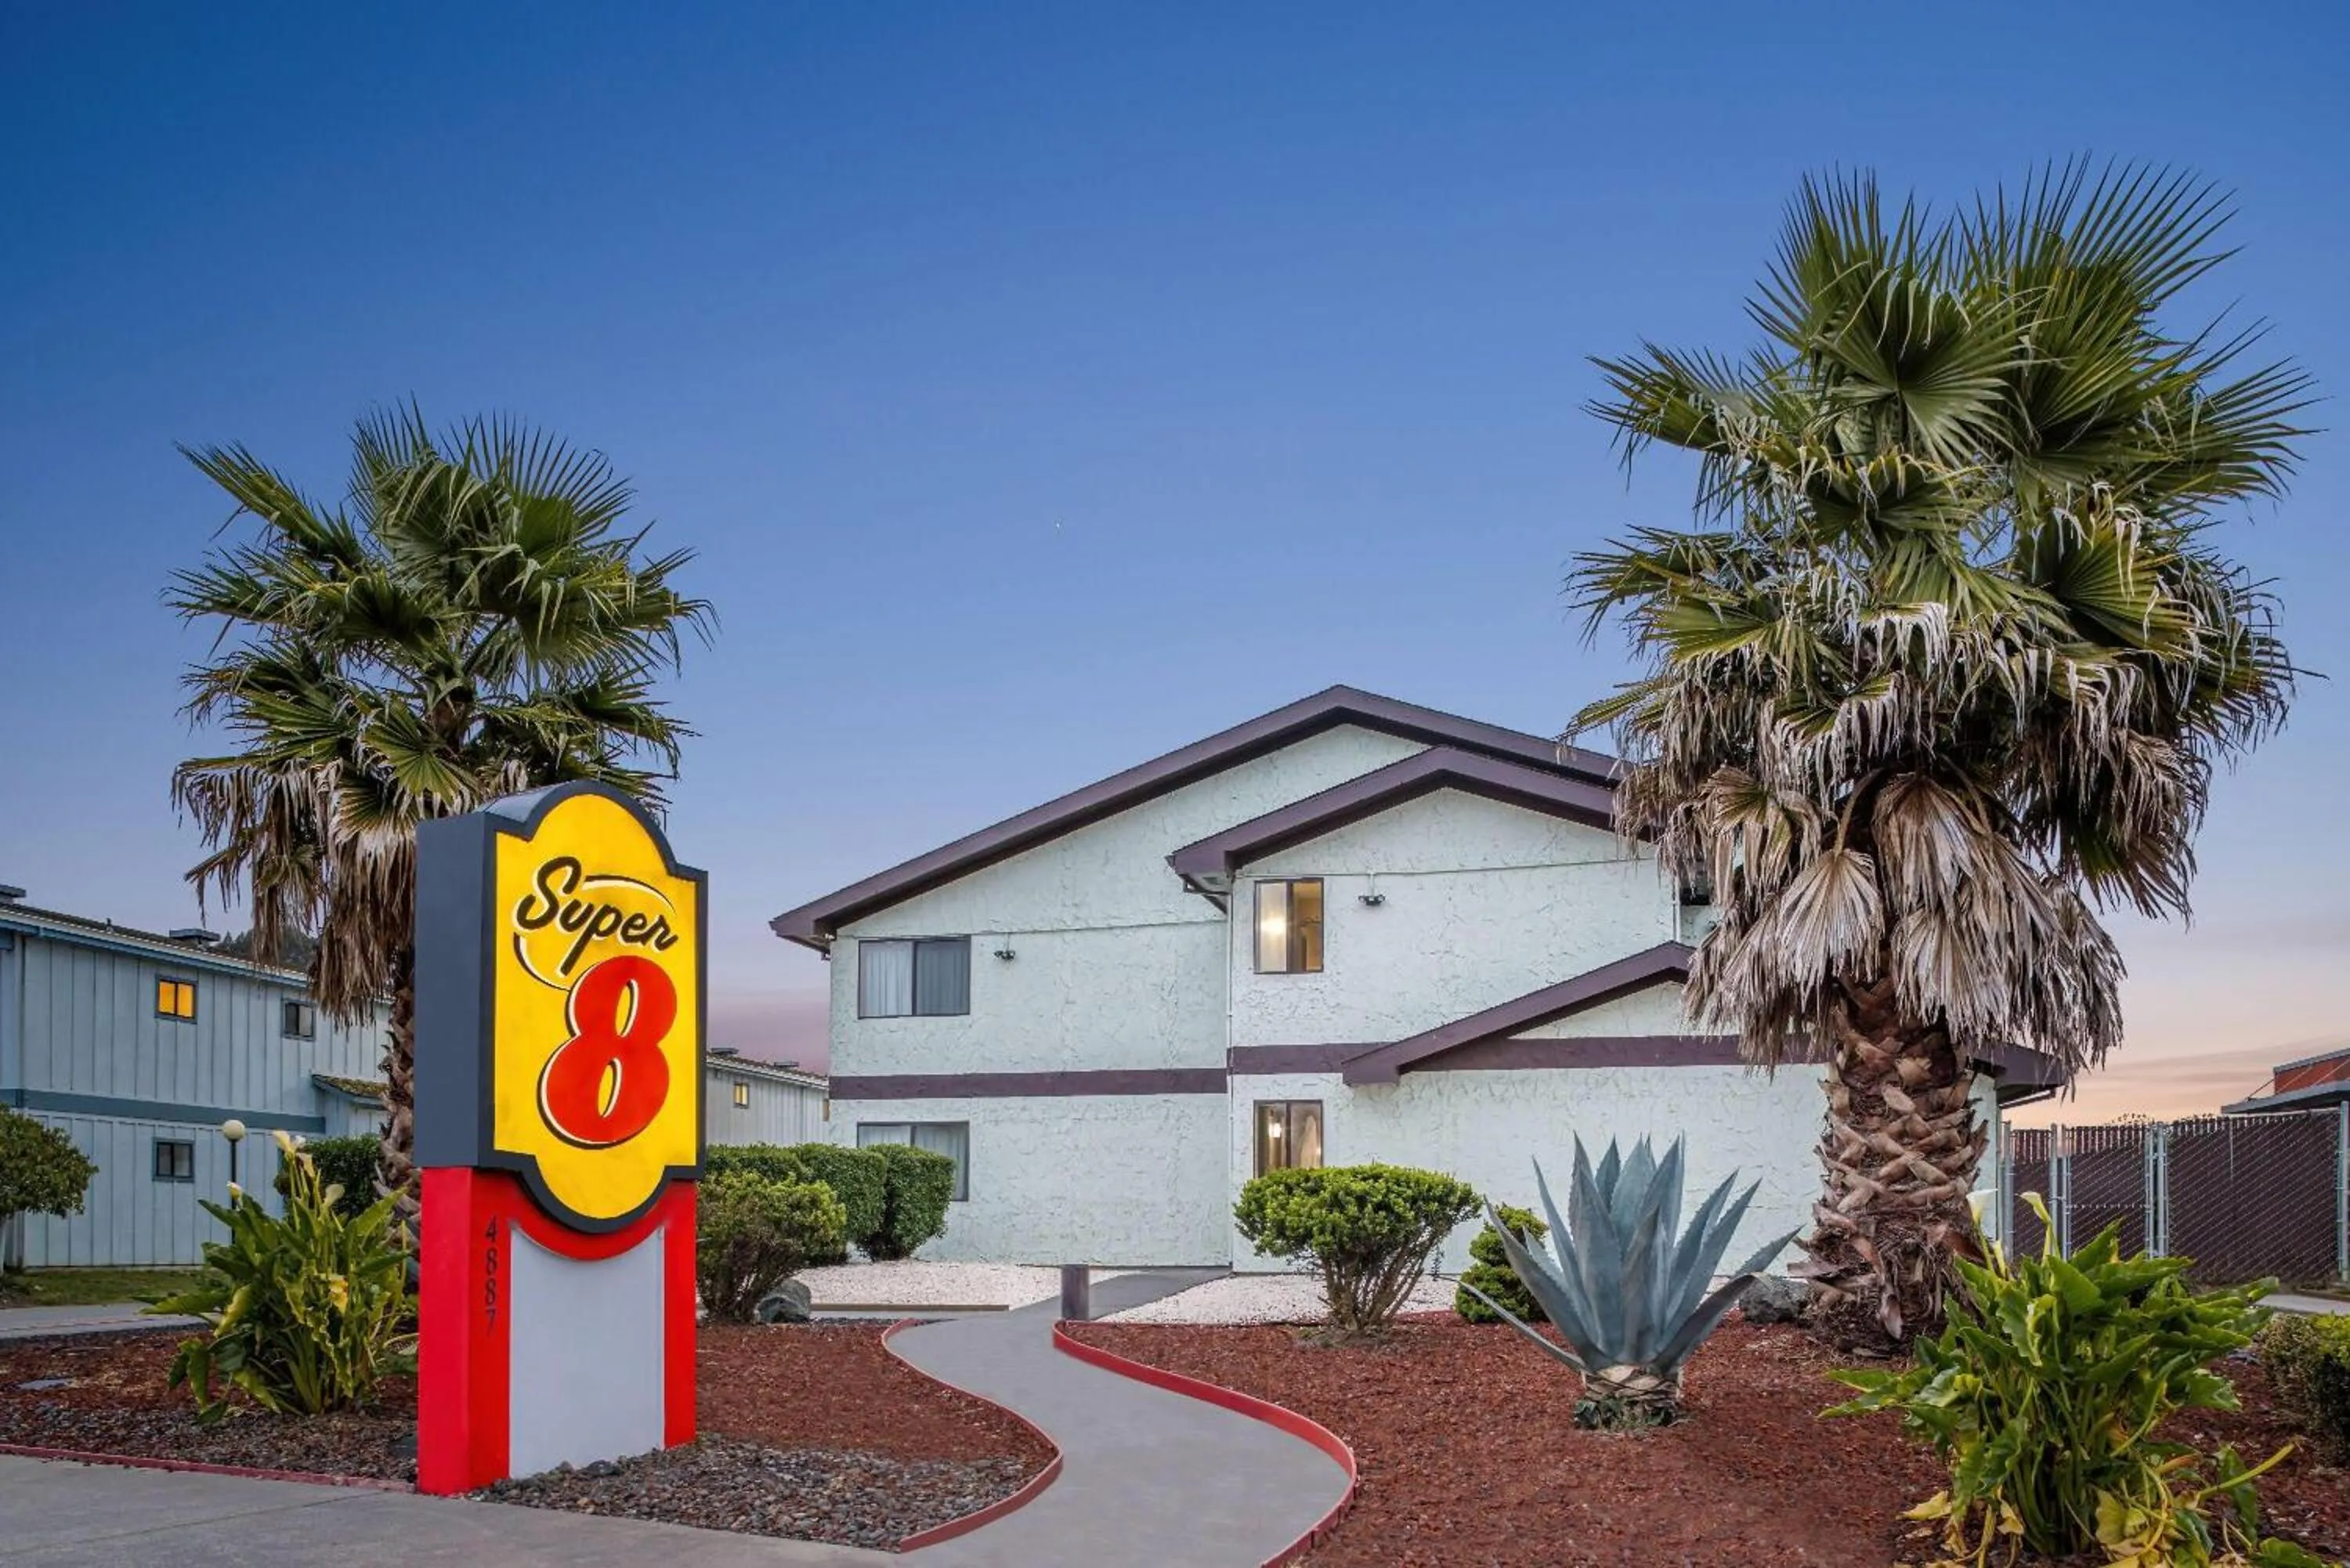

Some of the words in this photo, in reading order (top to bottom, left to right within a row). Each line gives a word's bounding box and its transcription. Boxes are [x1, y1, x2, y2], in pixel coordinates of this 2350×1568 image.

[515, 855, 679, 977] Super
[537, 955, 678, 1150] 8
[484, 1214, 498, 1336] 4887
